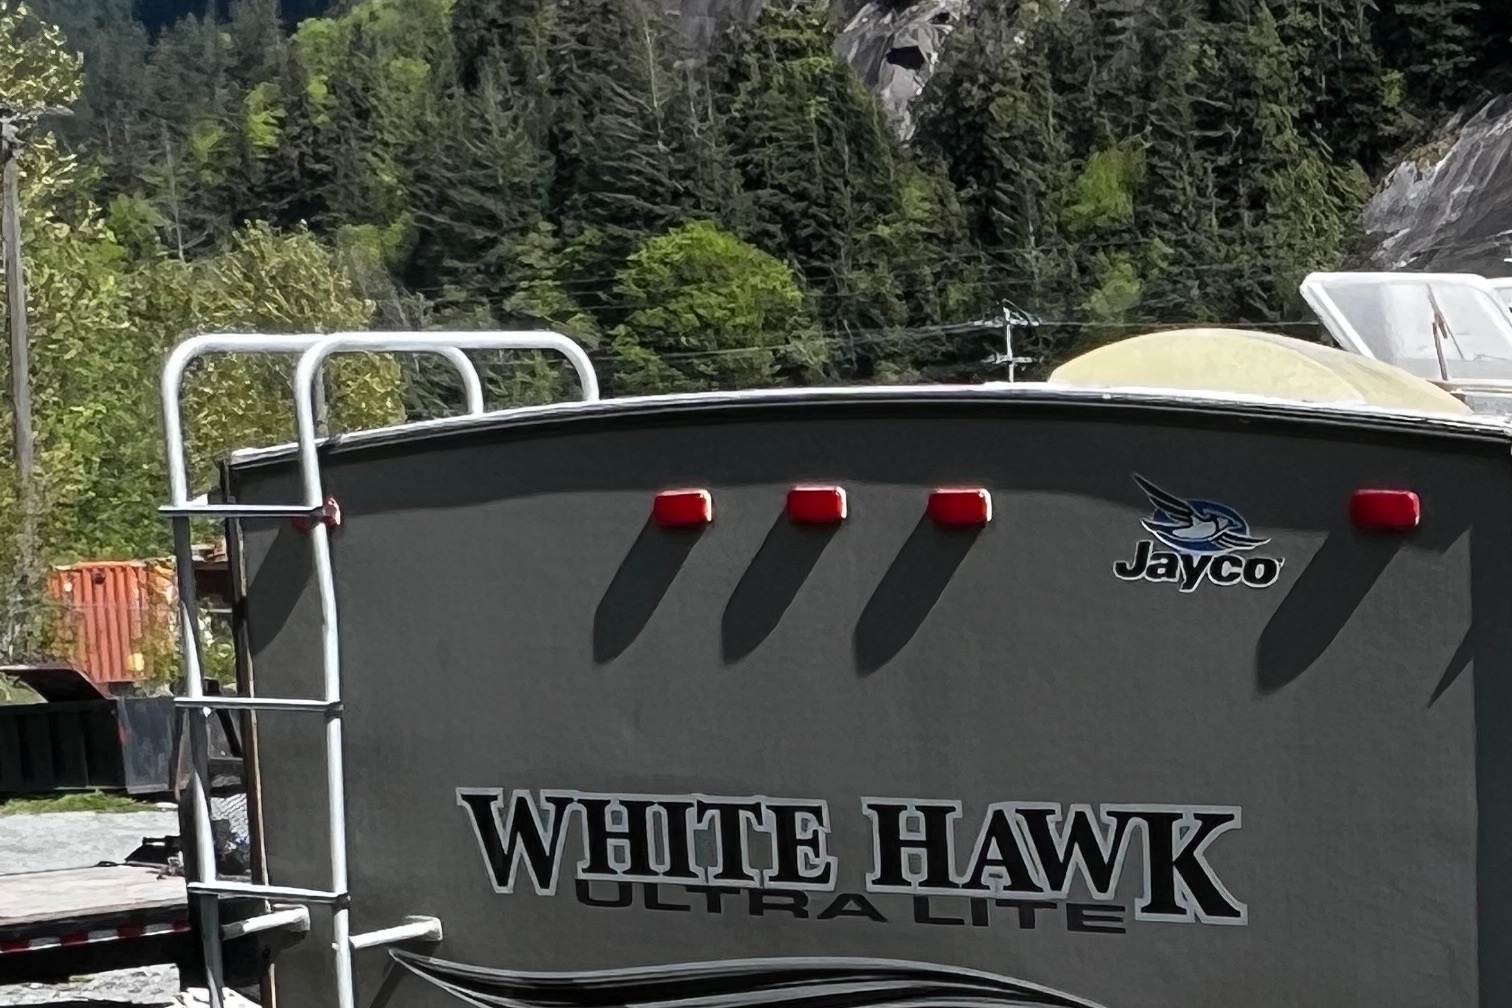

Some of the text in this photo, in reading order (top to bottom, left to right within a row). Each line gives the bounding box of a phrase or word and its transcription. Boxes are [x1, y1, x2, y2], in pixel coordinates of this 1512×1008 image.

[1112, 539, 1280, 593] Jayco
[455, 786, 1249, 926] WHITE HAWK
[575, 877, 1127, 935] ULTRA LITE
